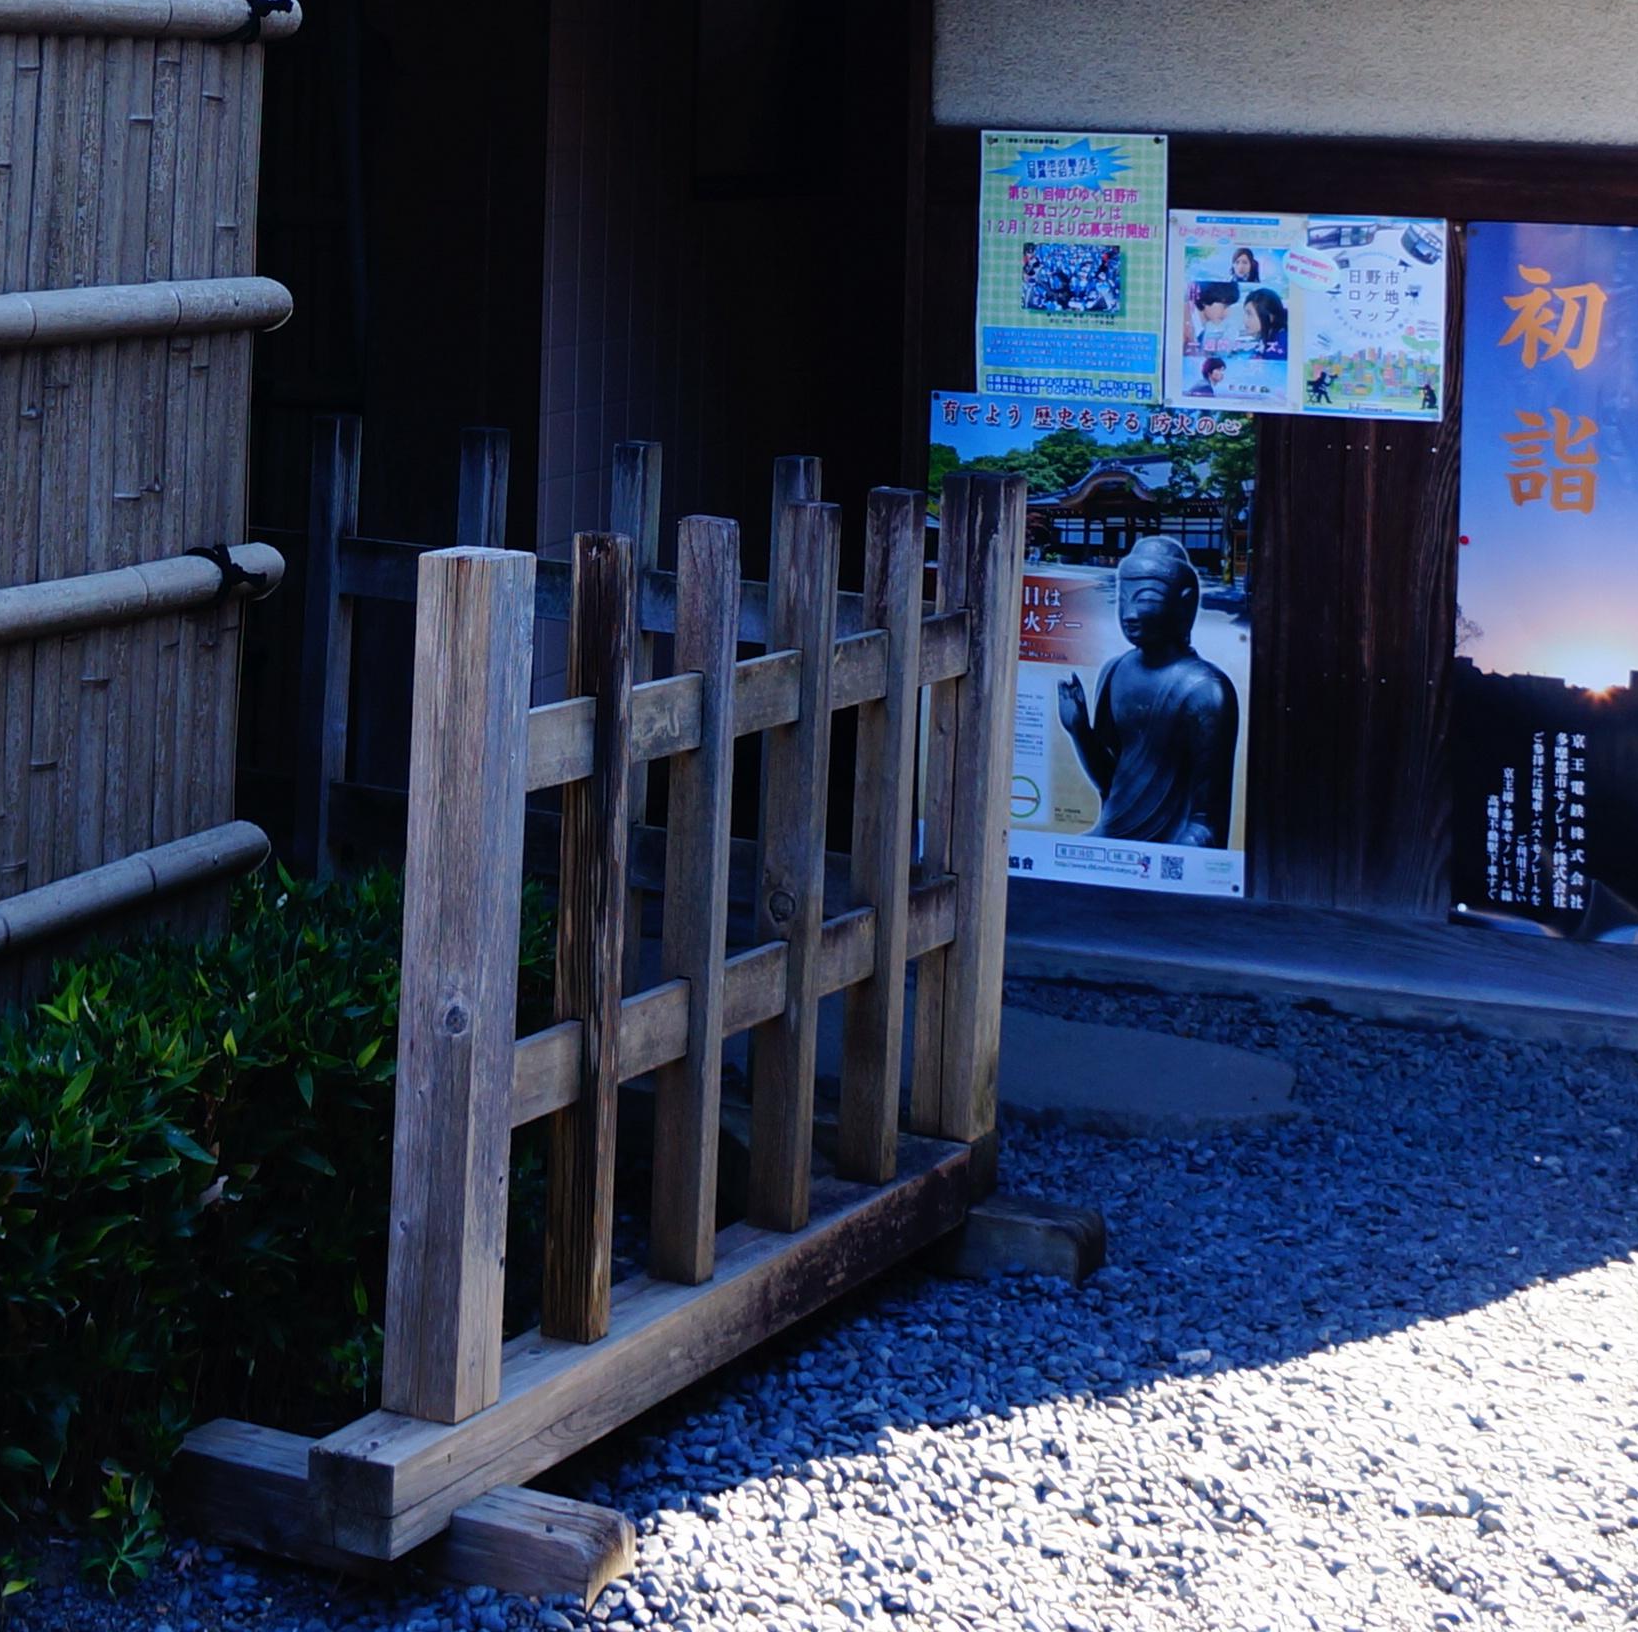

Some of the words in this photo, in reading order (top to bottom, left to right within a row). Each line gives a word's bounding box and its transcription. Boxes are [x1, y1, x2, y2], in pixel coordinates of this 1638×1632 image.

[1349, 269, 1400, 285] 日野市
[1349, 289, 1400, 306] ロケ地
[1349, 308, 1400, 323] マップ
[1498, 263, 1608, 516] 初詣
[941, 399, 1022, 427] 育てよう
[1031, 405, 1142, 434] 歴史を守る
[1149, 412, 1243, 438] 防火の心
[1023, 609, 1083, 634] 火デー
[1551, 731, 1570, 909] 多摩都市モノレール株式会社
[1569, 732, 1587, 910] 京王電鉄株式会社
